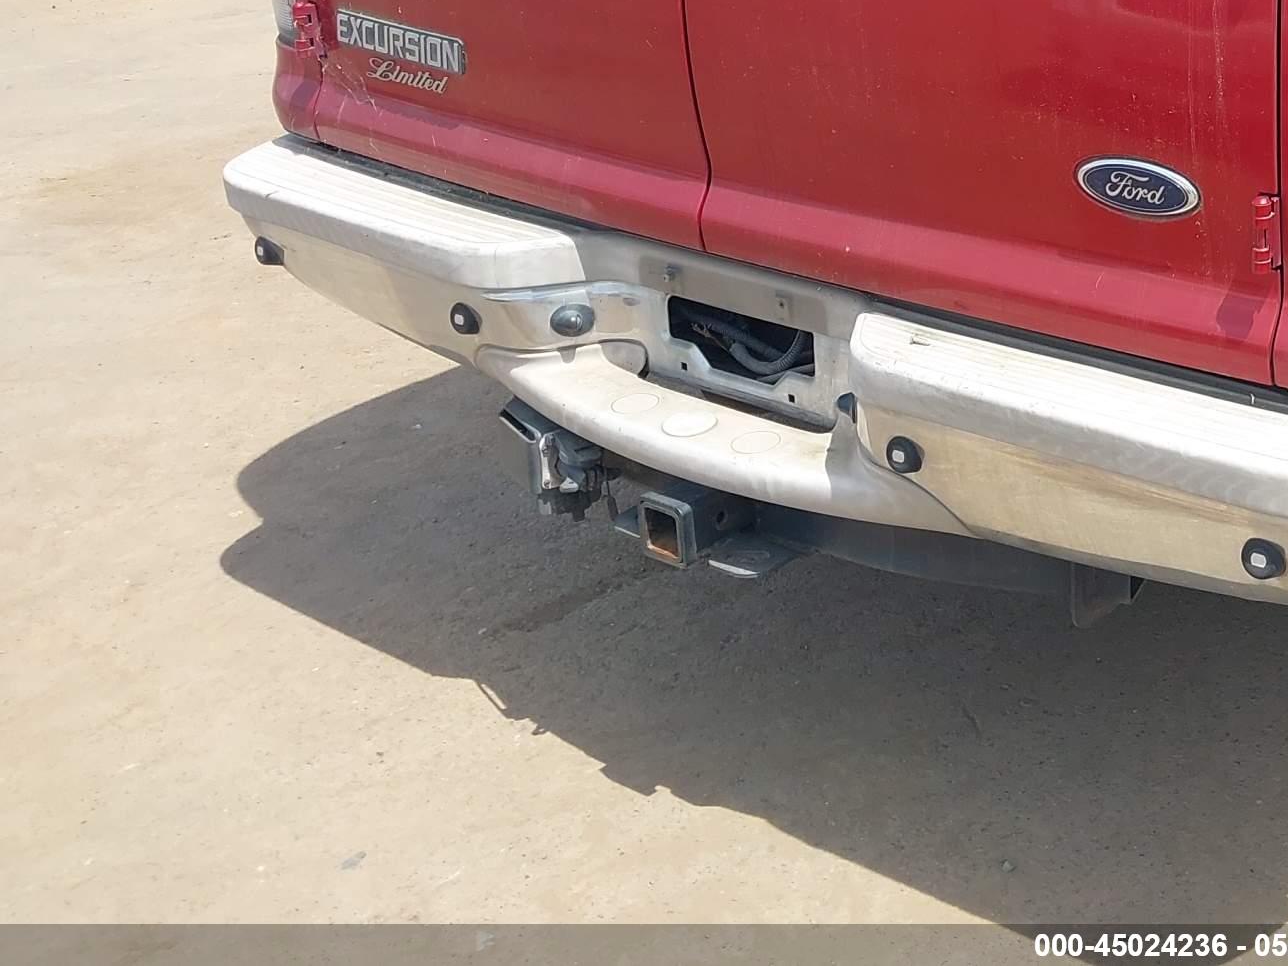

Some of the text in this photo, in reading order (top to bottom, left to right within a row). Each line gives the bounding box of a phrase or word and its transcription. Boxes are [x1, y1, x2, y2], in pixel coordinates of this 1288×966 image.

[337, 13, 460, 72] EXCURSION
[367, 58, 449, 94] Limited
[1106, 171, 1166, 205] Ford
